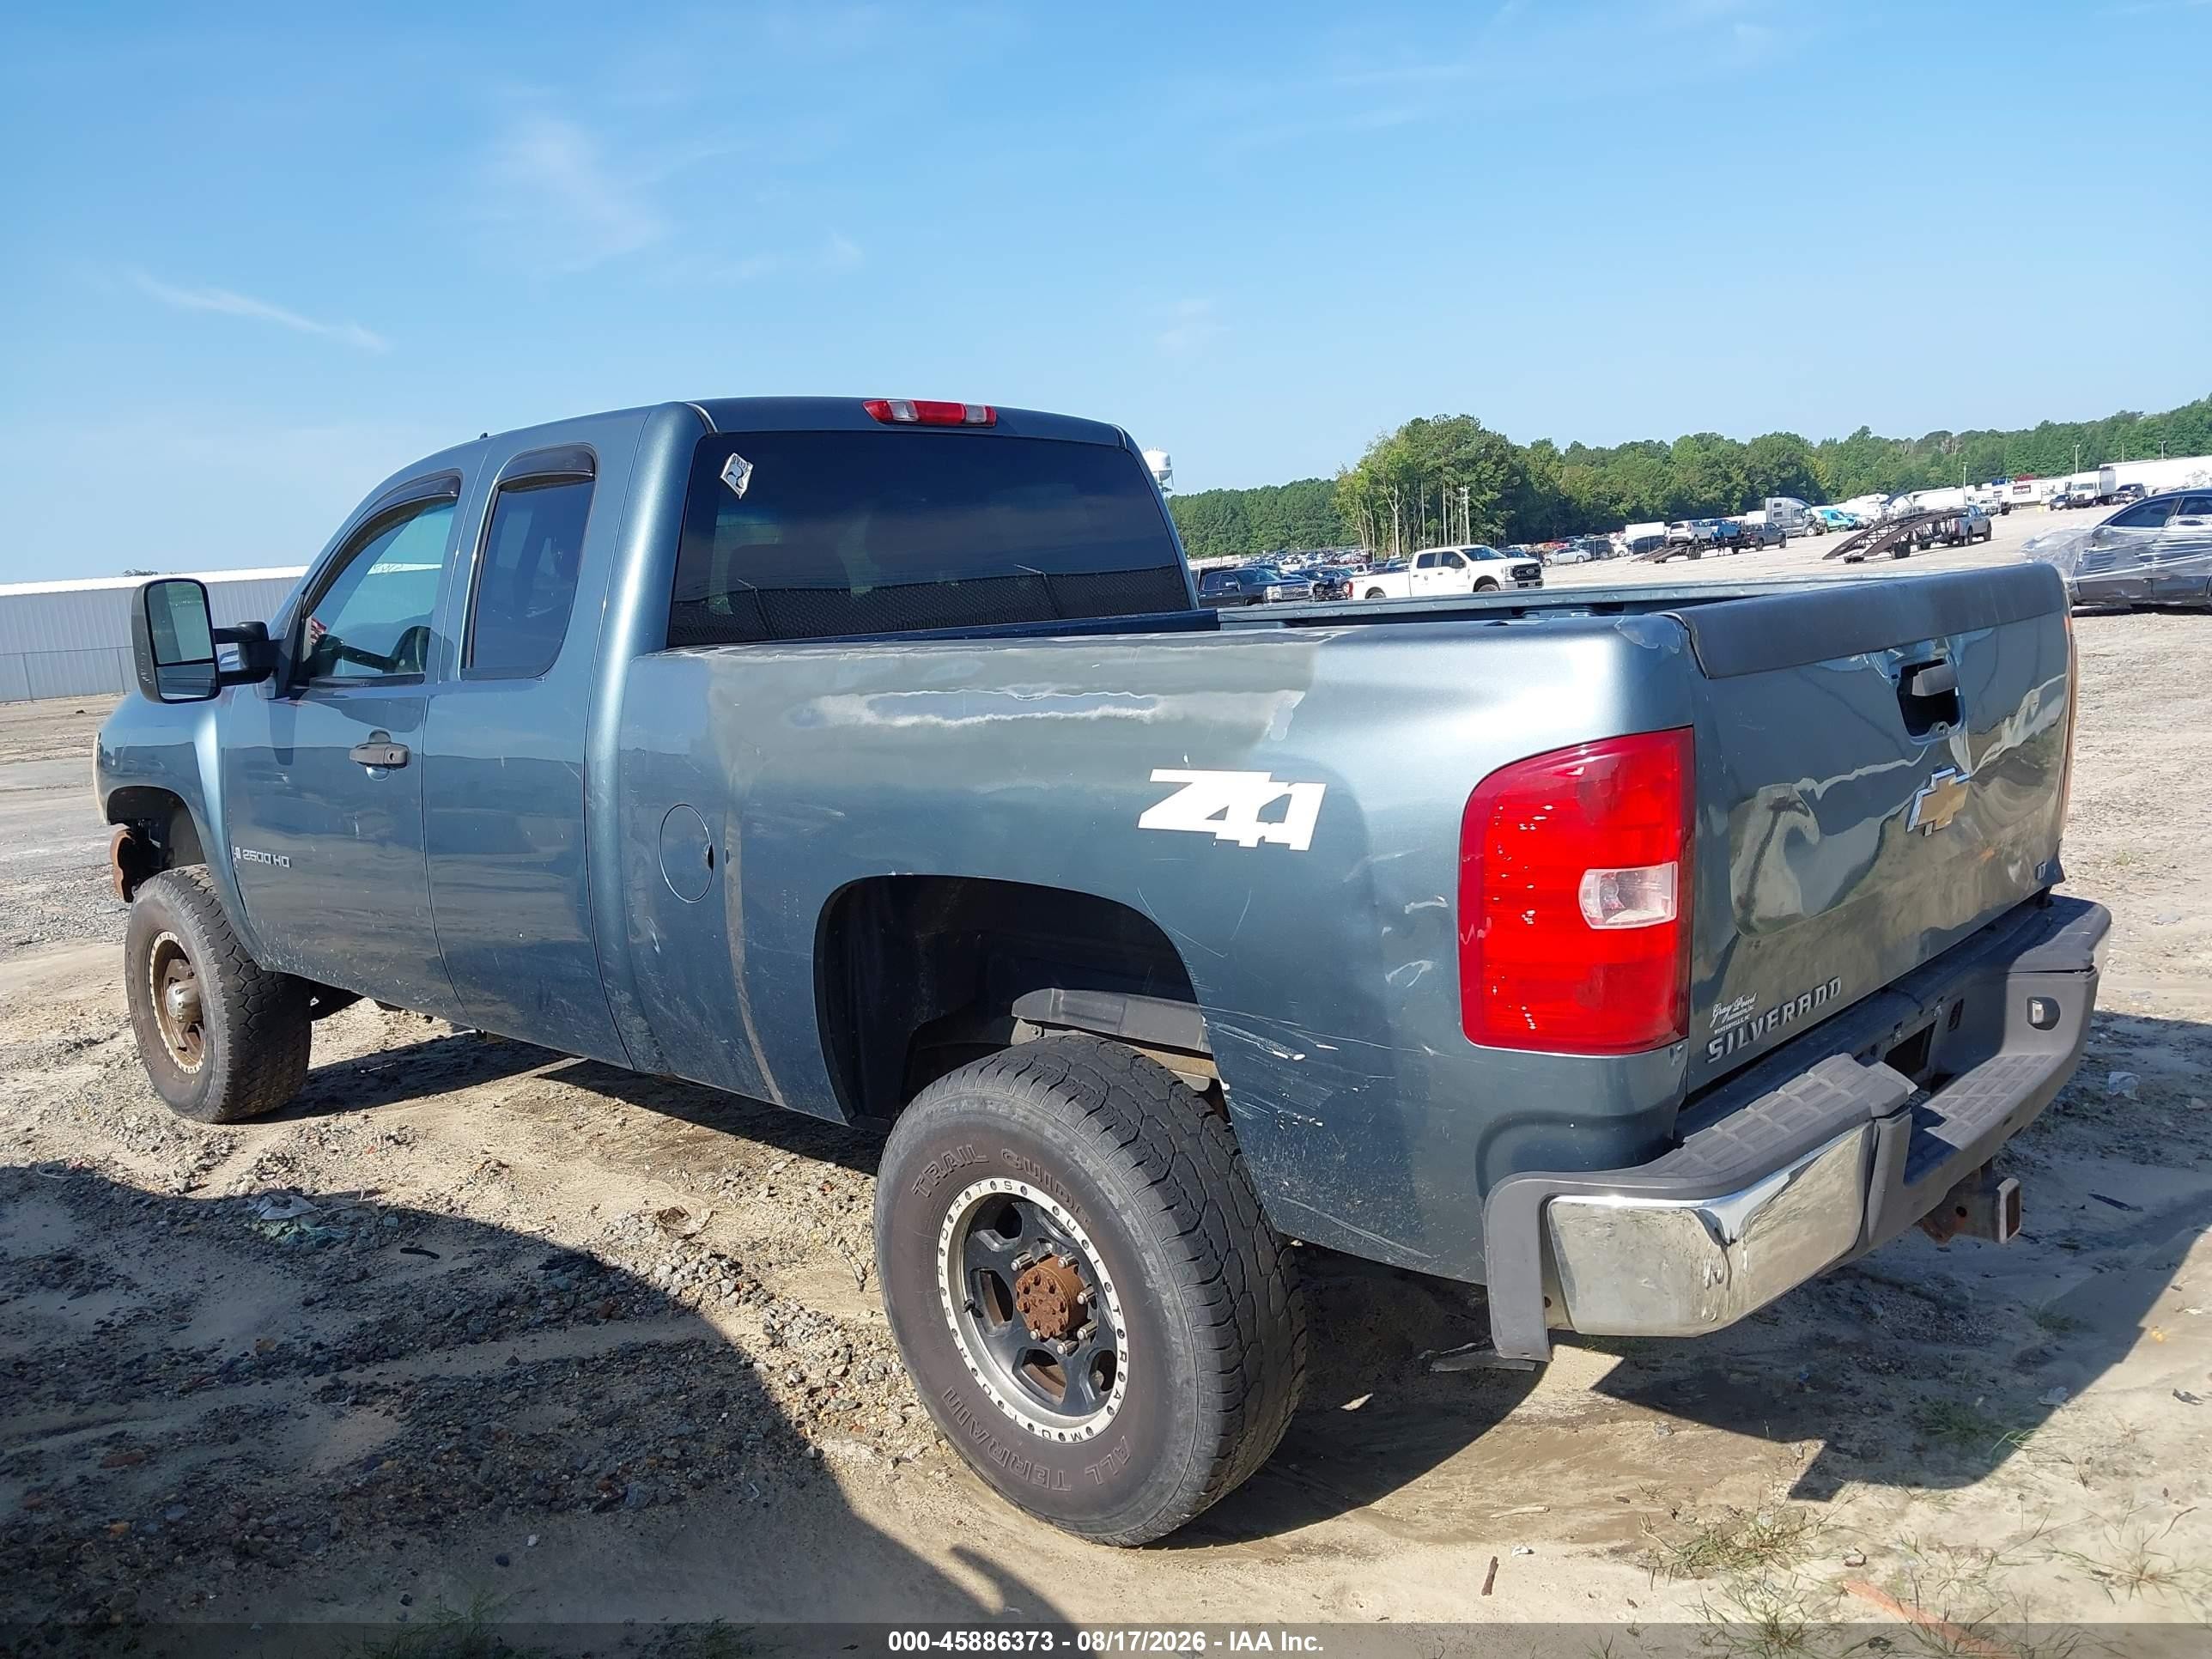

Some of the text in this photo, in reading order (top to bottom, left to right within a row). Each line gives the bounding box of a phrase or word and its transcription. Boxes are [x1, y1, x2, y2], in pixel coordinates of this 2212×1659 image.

[242, 848, 291, 869] 2500 HD
[1706, 975, 1842, 1065] SILVERADO
[911, 1144, 990, 1199] TRAIL
[941, 1385, 1133, 1492] ALL TERRAIN
